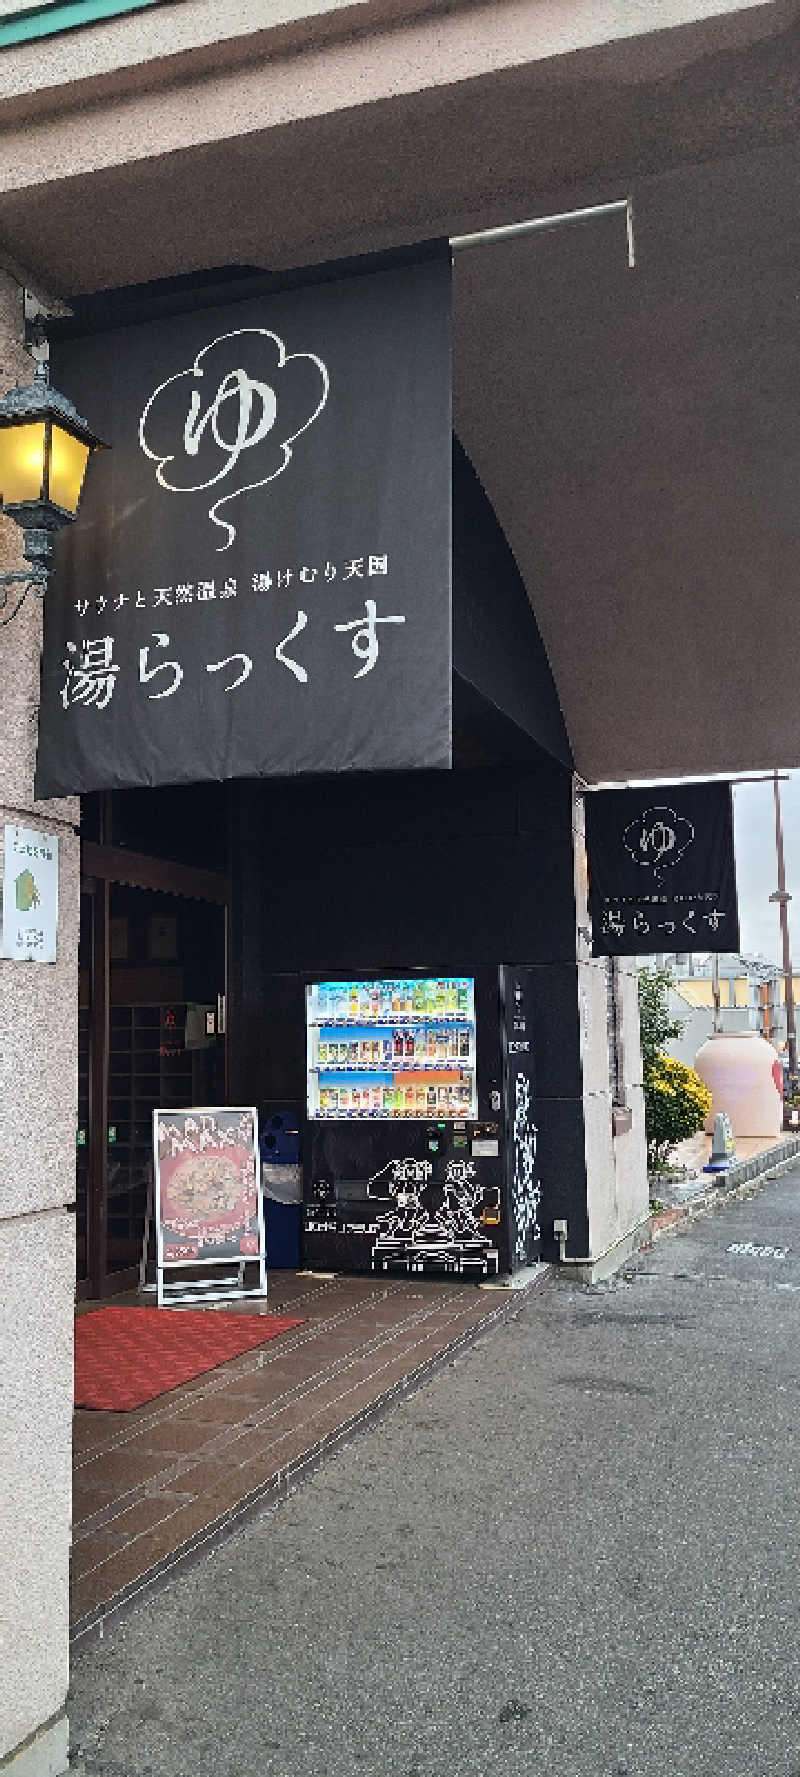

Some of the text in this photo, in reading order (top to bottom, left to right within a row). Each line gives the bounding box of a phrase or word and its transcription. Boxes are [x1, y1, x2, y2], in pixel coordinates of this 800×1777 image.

[183, 368, 278, 465] ゆ
[74, 553, 390, 618] サウナと天然温泉 湯けむり天国
[59, 598, 406, 710] 湯らっくす
[600, 908, 726, 936] 湯らっくす
